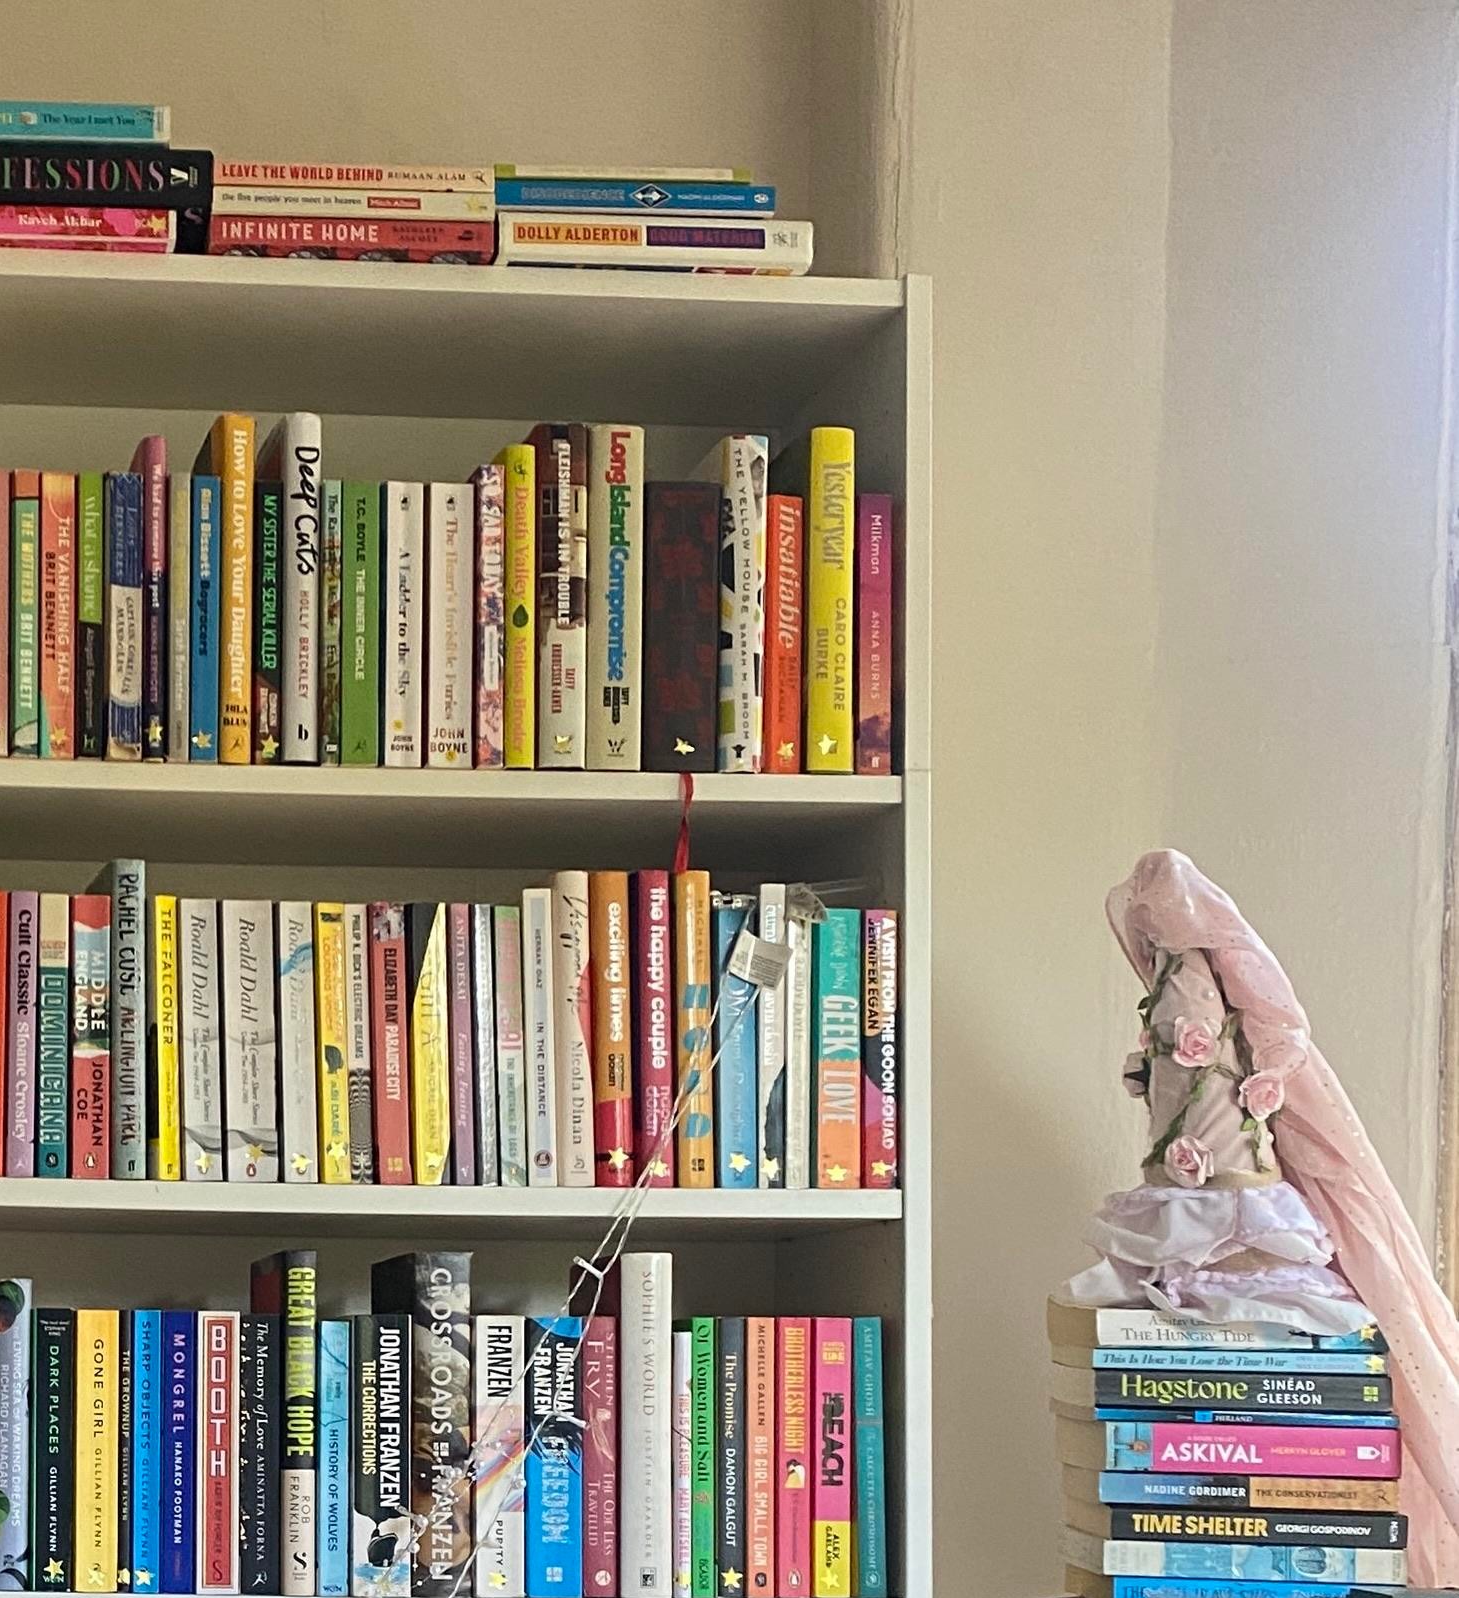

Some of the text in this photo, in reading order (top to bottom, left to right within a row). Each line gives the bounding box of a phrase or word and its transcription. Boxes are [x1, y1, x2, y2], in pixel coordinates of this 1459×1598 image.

[221, 221, 380, 244] INFINITE HOME
[516, 225, 639, 244] DOLLY ALDERTON
[290, 446, 320, 576] Deep Cuts
[871, 515, 882, 575] Milkman
[871, 611, 880, 700] ANNA BURNS
[605, 902, 622, 982] exciting
[822, 995, 857, 1125] GEEK LOVE
[76, 1088, 89, 1120] COE
[91, 1061, 103, 1146] JONATHAN
[48, 1345, 61, 1454] DARK PLACES
[93, 1339, 104, 1438] GONE GIRL
[173, 1334, 185, 1434] MONGREL
[362, 1360, 377, 1475] THE CORRECTIONS
[380, 1326, 400, 1507] JONATHAN FRANZEN
[1121, 1375, 1248, 1404] Hagstone
[1257, 1393, 1322, 1405] GLEESON
[1263, 1378, 1316, 1391] SINÉAD
[1161, 1443, 1262, 1464] ASKIVAL
[48, 1466, 59, 1552] GILLIAN FLYNN
[1133, 1514, 1268, 1537] TIME SHELTER
